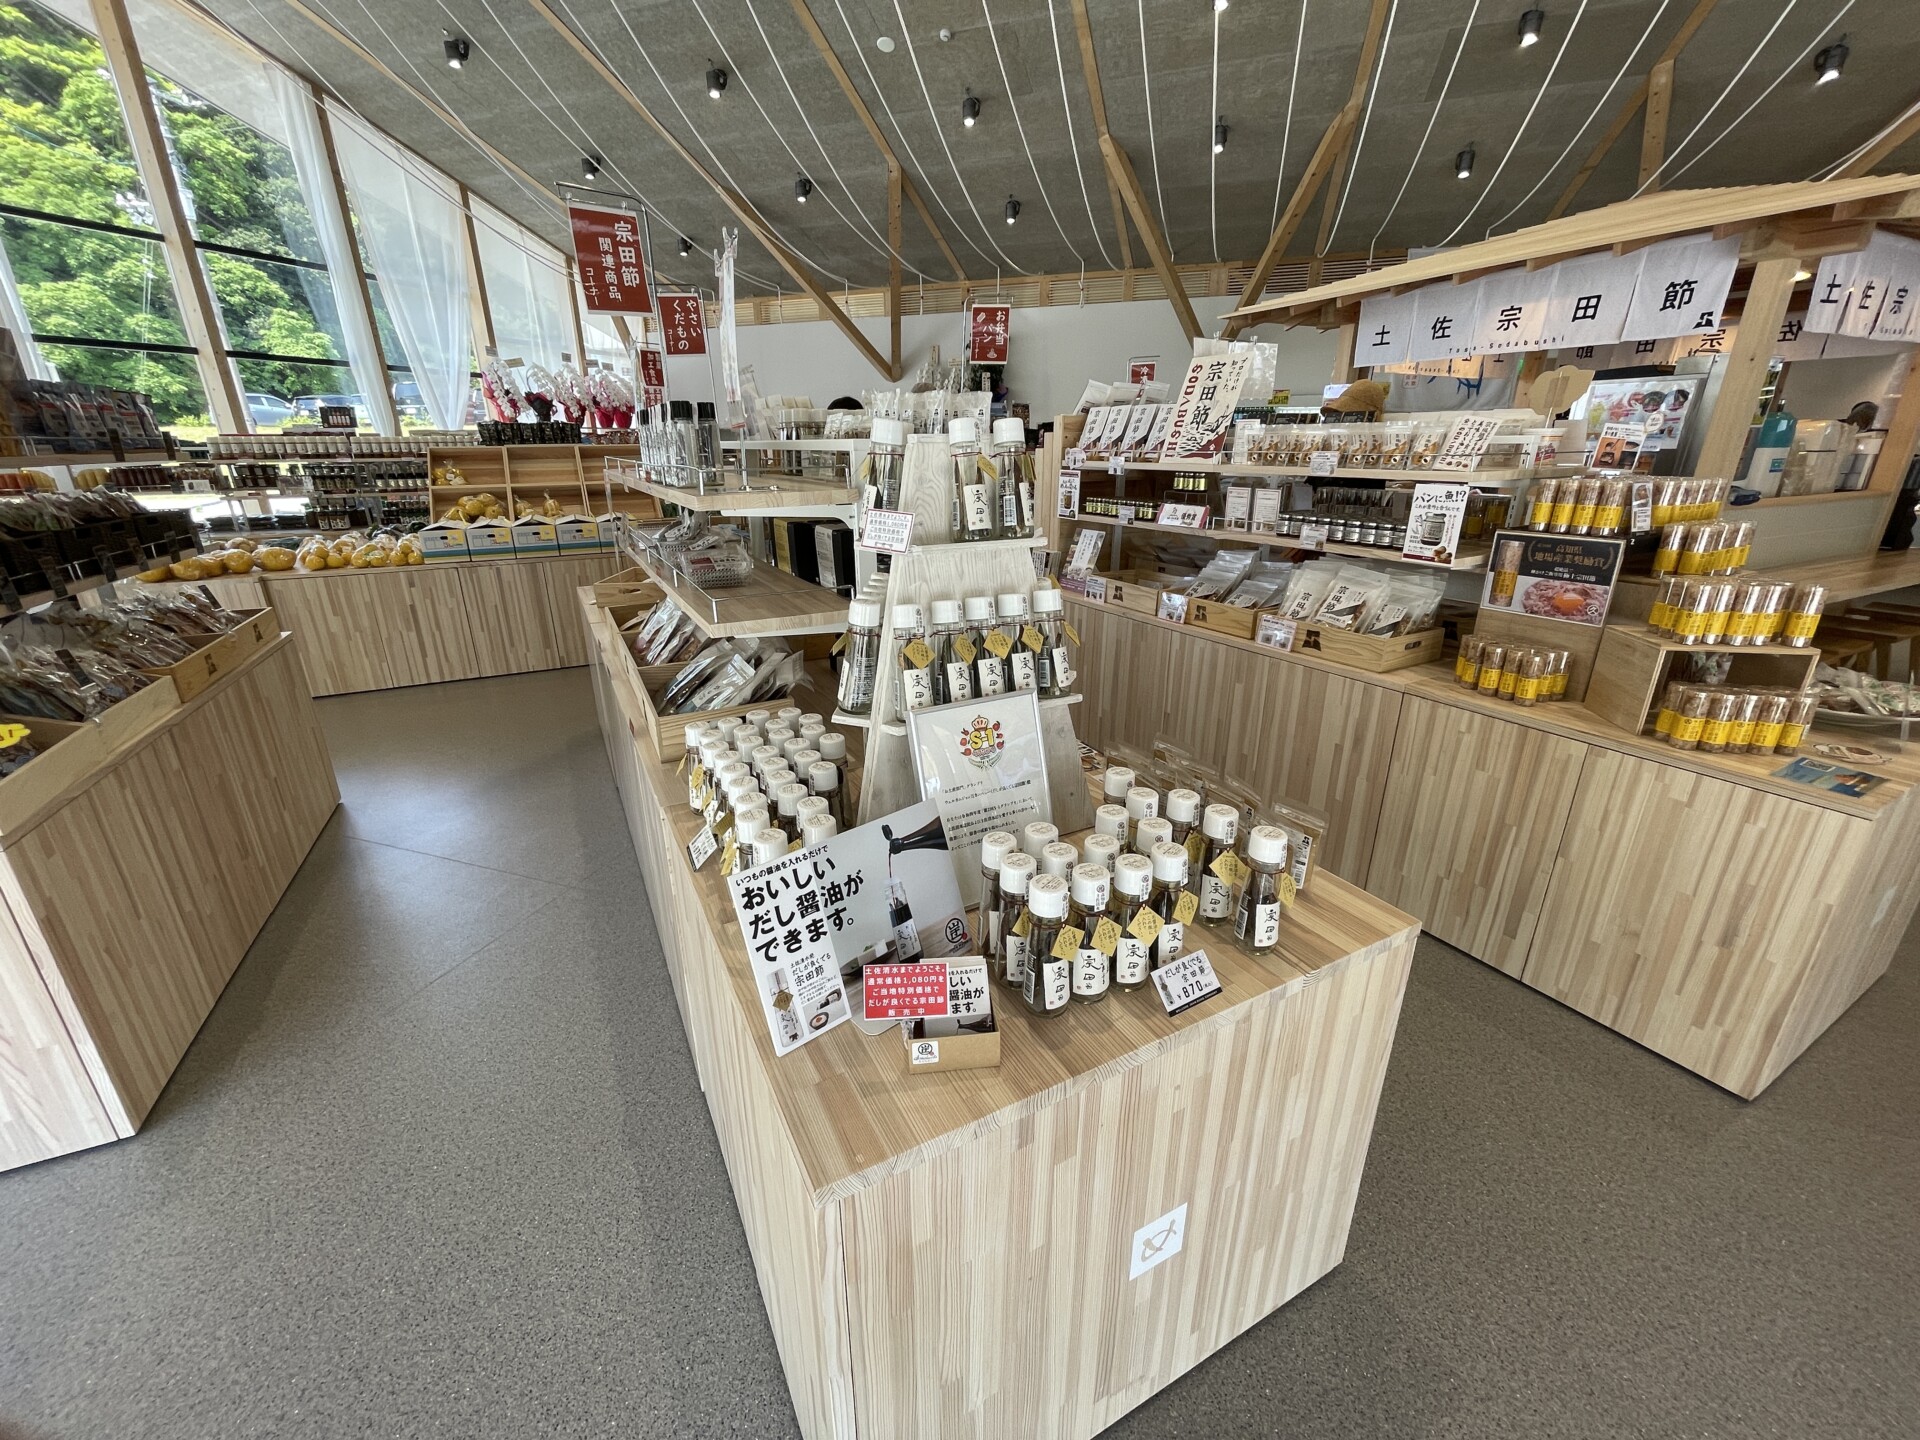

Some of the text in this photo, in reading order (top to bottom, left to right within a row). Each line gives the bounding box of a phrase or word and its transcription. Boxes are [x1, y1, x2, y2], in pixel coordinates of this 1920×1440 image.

[598, 237, 621, 299] 関連商品
[614, 221, 640, 288] 宗田節
[585, 267, 598, 306] コーナー
[673, 300, 689, 350] くだもの
[686, 300, 701, 337] やさい
[996, 310, 1006, 345] お弁当
[1371, 279, 1700, 347] 土佐宗田節
[982, 323, 993, 342] パン
[1164, 363, 1204, 458] SODABUSHI
[1190, 361, 1227, 431] 宗田節
[1414, 490, 1467, 504] パンに魚!?
[1556, 544, 1583, 554] 高知県
[1325, 585, 1349, 612] 宗田節
[970, 728, 994, 750] S-1
[736, 844, 828, 887] いつもの醤油を入れるだけで
[741, 857, 836, 911] おいしい
[749, 869, 864, 940] だし醤油が
[755, 906, 855, 963] できます。
[795, 965, 824, 987] 宗田節
[866, 966, 945, 975] 土佐清水までようこそ。
[868, 975, 944, 986] 通常価格1,080円を
[1182, 965, 1205, 983] 宗田節
[873, 986, 939, 996] ご当地特別価格で
[951, 1002, 976, 1014] ます。
